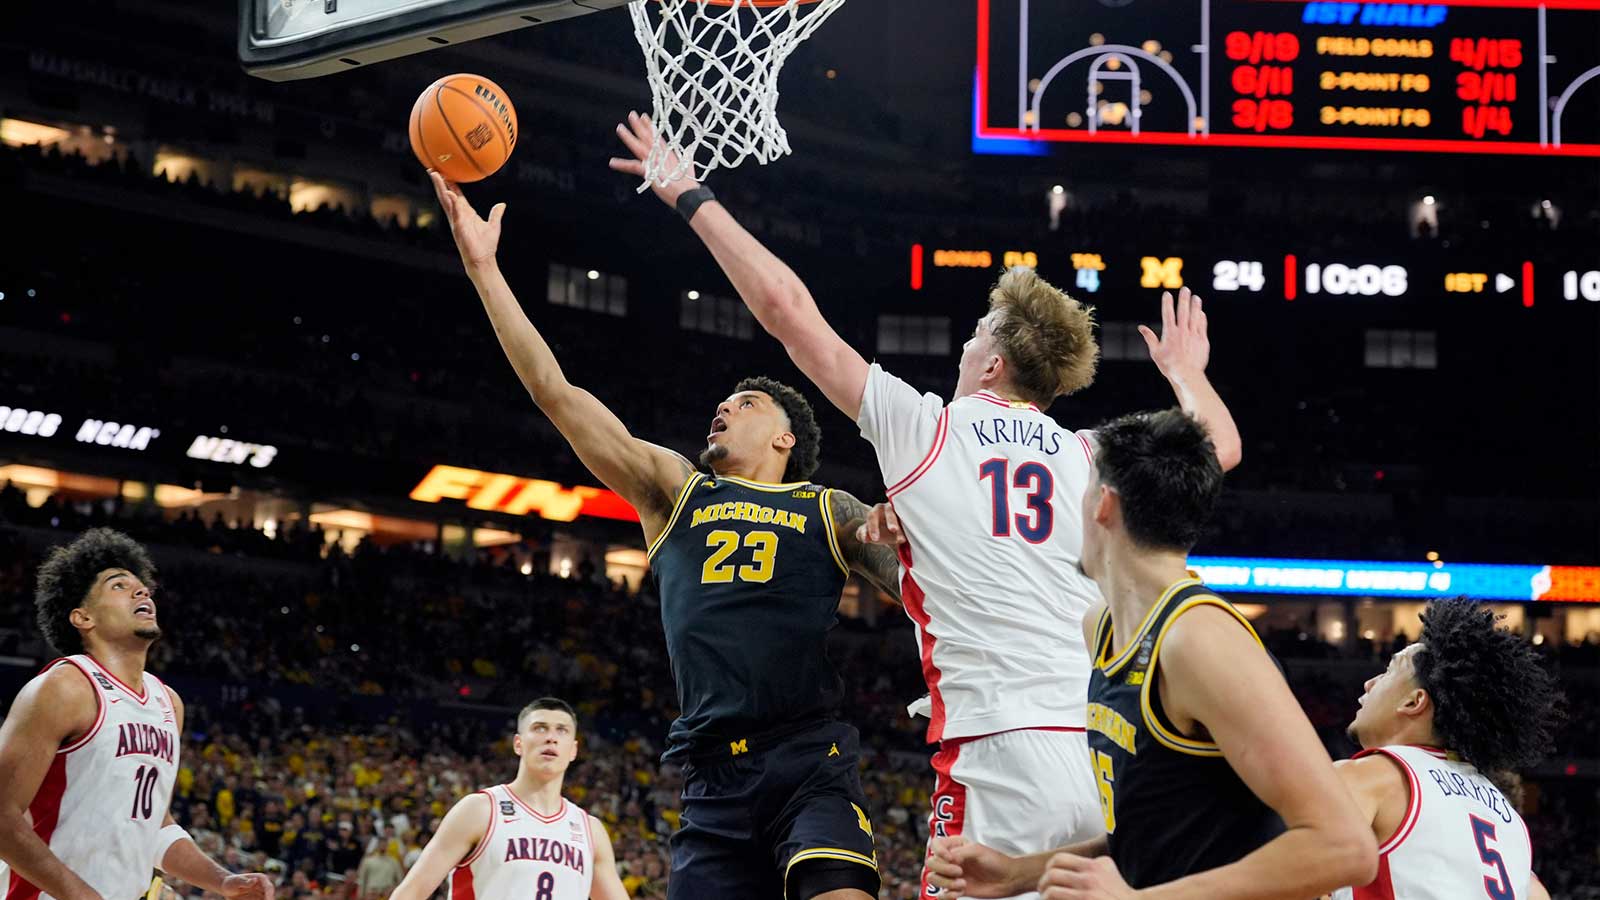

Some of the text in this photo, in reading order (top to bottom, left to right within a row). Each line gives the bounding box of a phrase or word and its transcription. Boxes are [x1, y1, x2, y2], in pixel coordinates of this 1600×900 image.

[1302, 2, 1448, 27] 1ST HALF
[1225, 31, 1299, 64] 9/19
[1317, 36, 1433, 58] FIELD GOALS
[1450, 37, 1522, 70] 4/15
[1232, 65, 1293, 98] 6/11
[1320, 71, 1430, 92] 2-POINT FG
[1456, 71, 1516, 104] 3/11
[1232, 99, 1293, 132] 3/8
[1320, 106, 1431, 127] 3-POINT FG
[1463, 105, 1512, 138] 1/4
[934, 250, 991, 268] BONUS
[1140, 256, 1265, 291] M 24
[1076, 268, 1099, 292] 4
[1305, 263, 1408, 296] 10:06
[1444, 272, 1488, 292] 1ST
[1563, 270, 1600, 301] 10
[186, 435, 278, 468] MEN'S
[972, 418, 1062, 455] KRIVAS
[690, 502, 807, 534] MICHIGAN
[979, 458, 1054, 545] 13
[701, 530, 779, 584] 23
[1252, 567, 1344, 588] THERE
[1346, 570, 1428, 591] WERE
[1428, 572, 1452, 591] 4
[115, 722, 174, 766] ARIZONA
[730, 739, 748, 756] M
[131, 764, 159, 820] 10
[504, 837, 584, 876] ARIZONA
[1469, 813, 1516, 900] 5
[535, 871, 555, 900] 8
